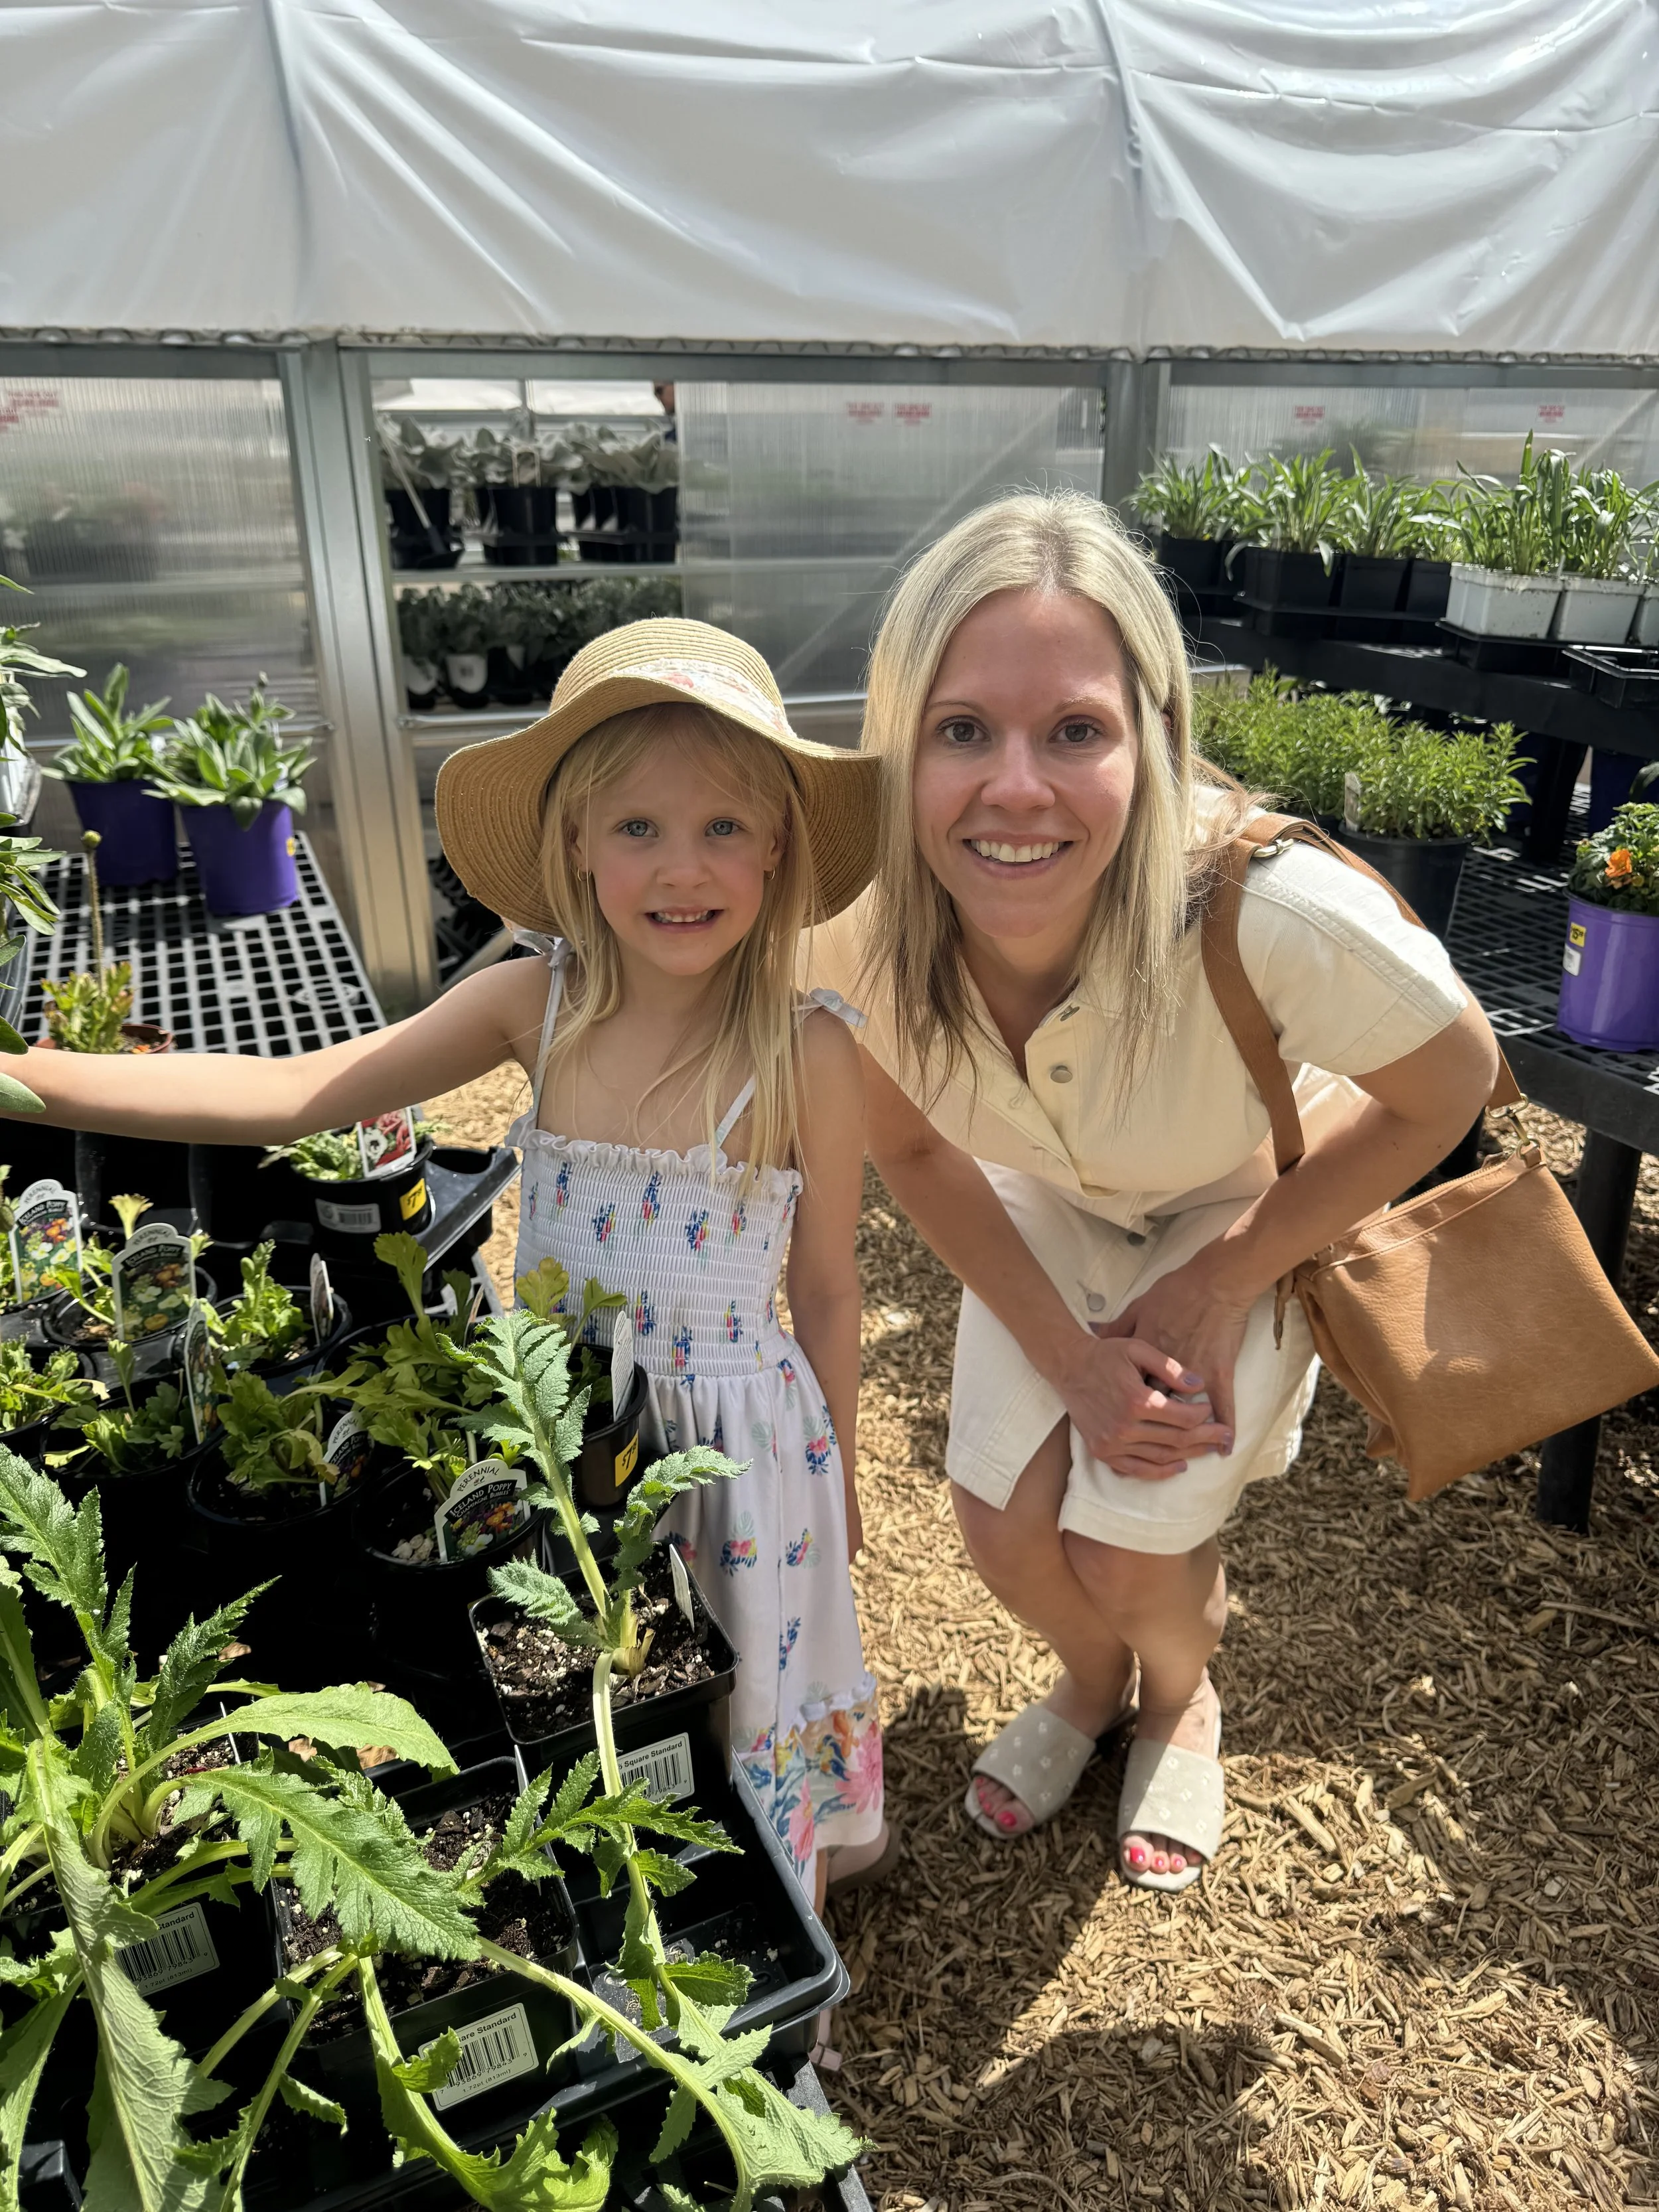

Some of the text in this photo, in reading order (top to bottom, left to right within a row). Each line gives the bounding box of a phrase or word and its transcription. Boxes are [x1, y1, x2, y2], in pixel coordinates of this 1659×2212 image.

[457, 1466, 500, 1492] PERENNIAL
[450, 1483, 512, 1516] ICELAND POPPY
[624, 1741, 682, 1767] Square Standard
[476, 2012, 517, 2033] Standard
[455, 2072, 482, 2087] 93869
[486, 2058, 513, 2073] 79843
